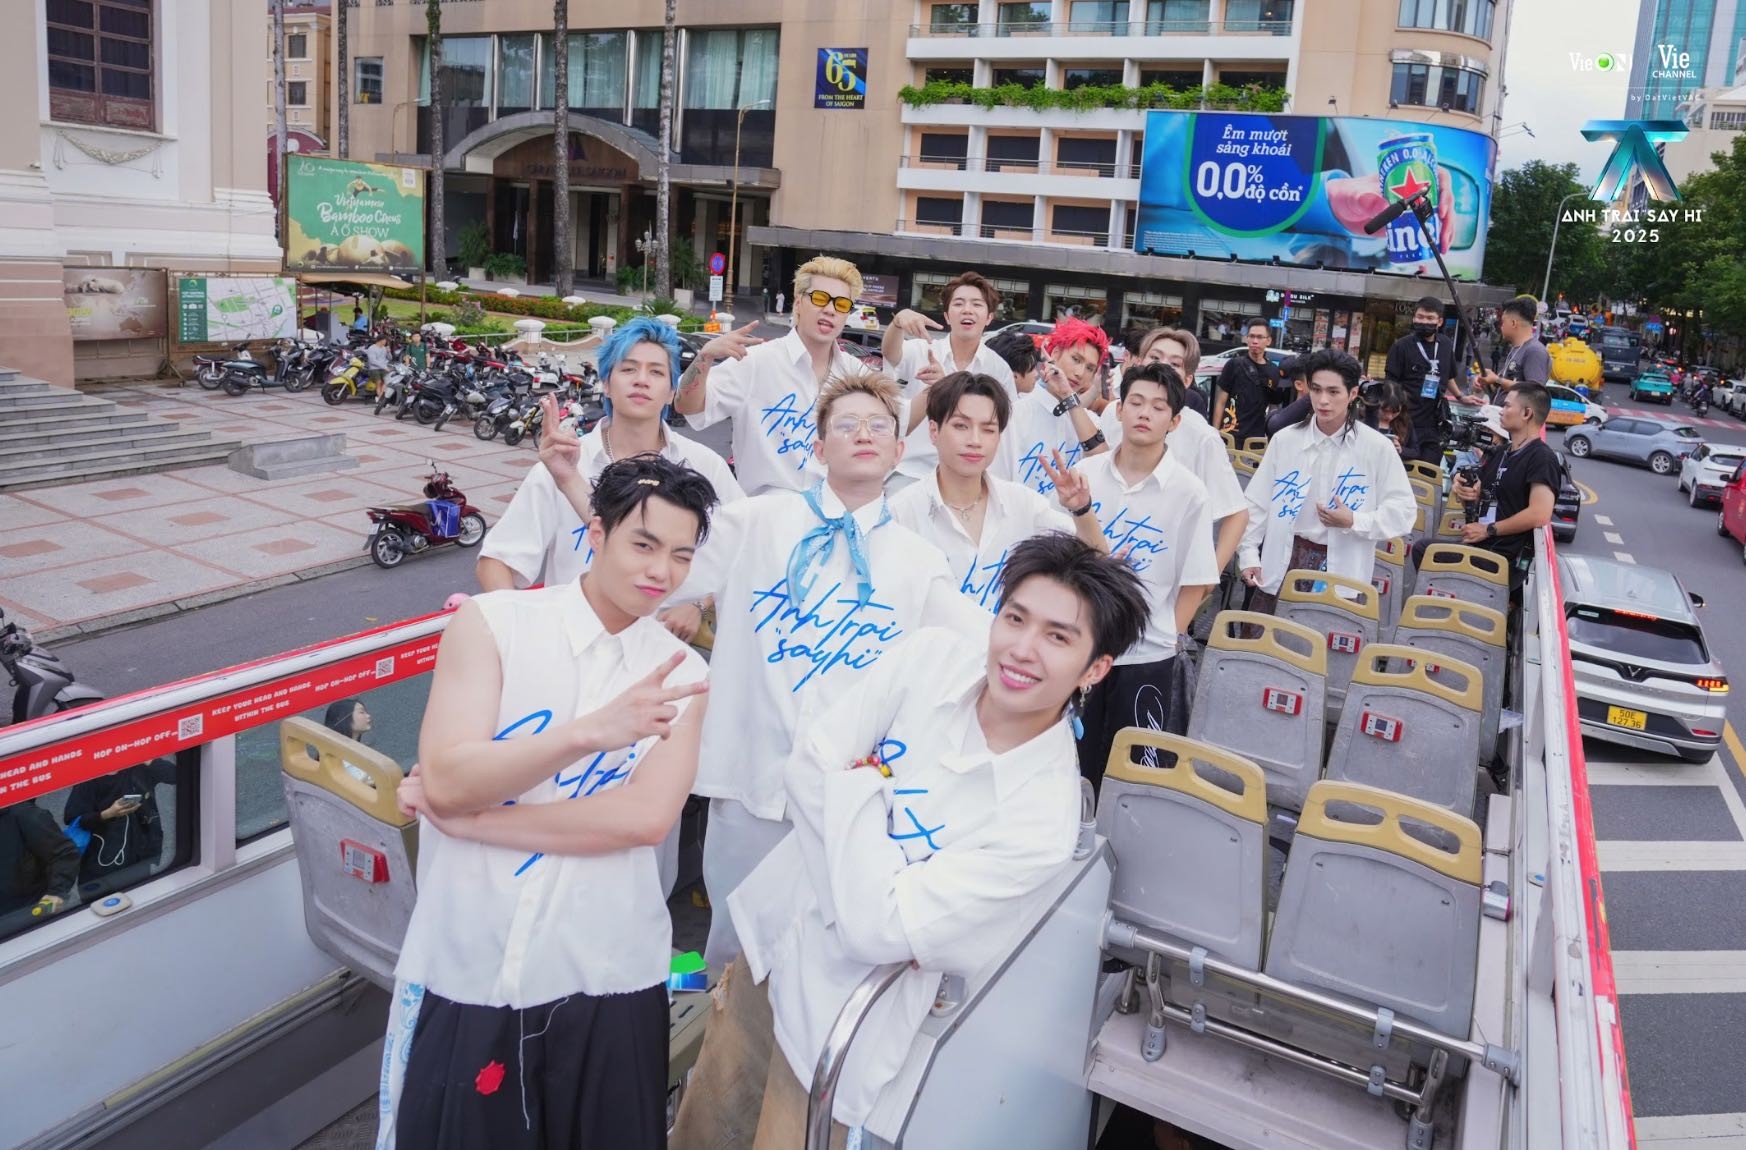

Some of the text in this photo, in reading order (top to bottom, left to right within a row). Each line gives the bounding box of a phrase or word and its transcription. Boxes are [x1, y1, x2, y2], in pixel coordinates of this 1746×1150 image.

[826, 51, 857, 92] 65
[1222, 124, 1288, 143] Êm mượt
[1216, 141, 1292, 157] sảng khoái
[1245, 184, 1266, 203] độ
[317, 202, 373, 224] Bamboo
[353, 226, 390, 238] SHOW
[315, 682, 330, 692] HOP
[212, 681, 311, 717] KEEP YOUR HEAD AND HANDS
[234, 699, 290, 722] WITHIN THE BUS
[93, 748, 113, 760] HOP
[0, 749, 83, 780] HEAD AND HANDS
[10, 779, 30, 791] THE
[32, 772, 52, 784] BUS
